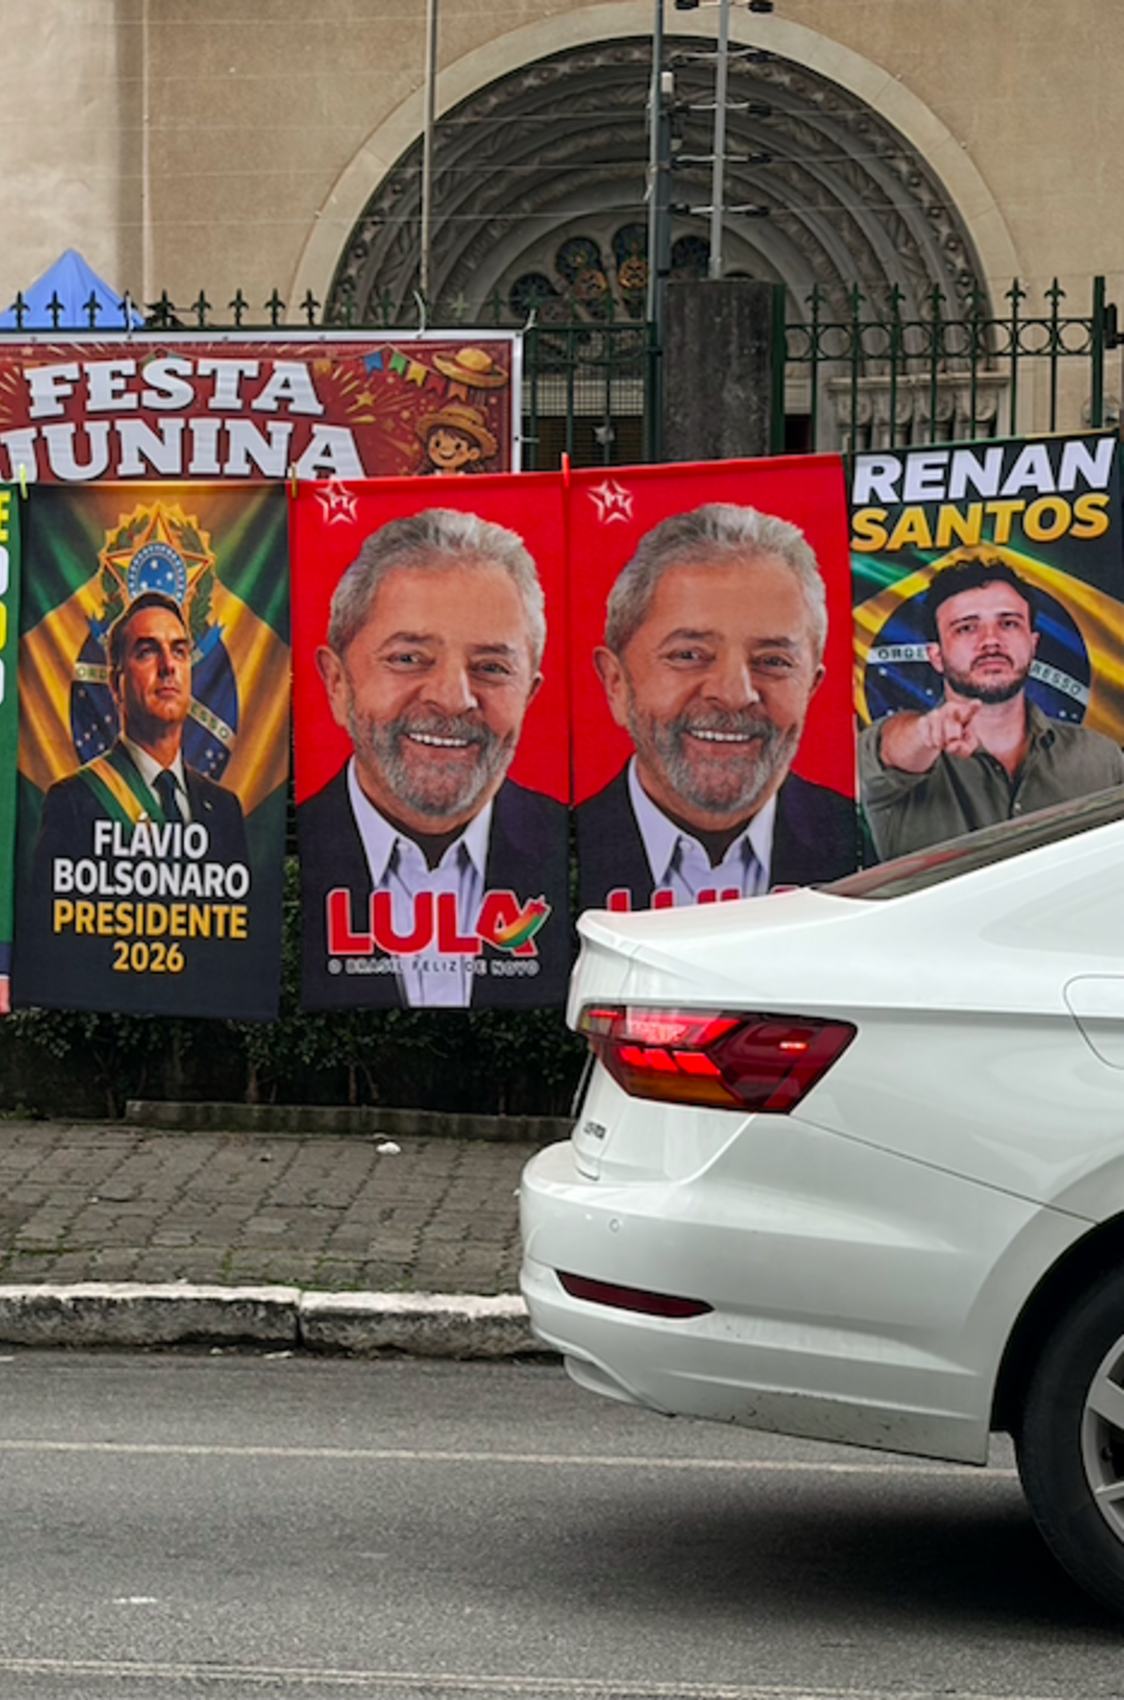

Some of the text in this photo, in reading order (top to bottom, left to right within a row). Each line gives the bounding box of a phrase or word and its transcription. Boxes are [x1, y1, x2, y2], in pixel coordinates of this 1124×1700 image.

[23, 358, 325, 419] FESTA
[852, 438, 1116, 504] RENAN
[850, 492, 1110, 552] SANTOS
[53, 858, 250, 899] BOLSONARO
[53, 899, 248, 939] PRESIDENTE
[327, 888, 544, 957] LULA
[112, 940, 185, 973] 2026
[412, 959, 458, 974] FELIZ
